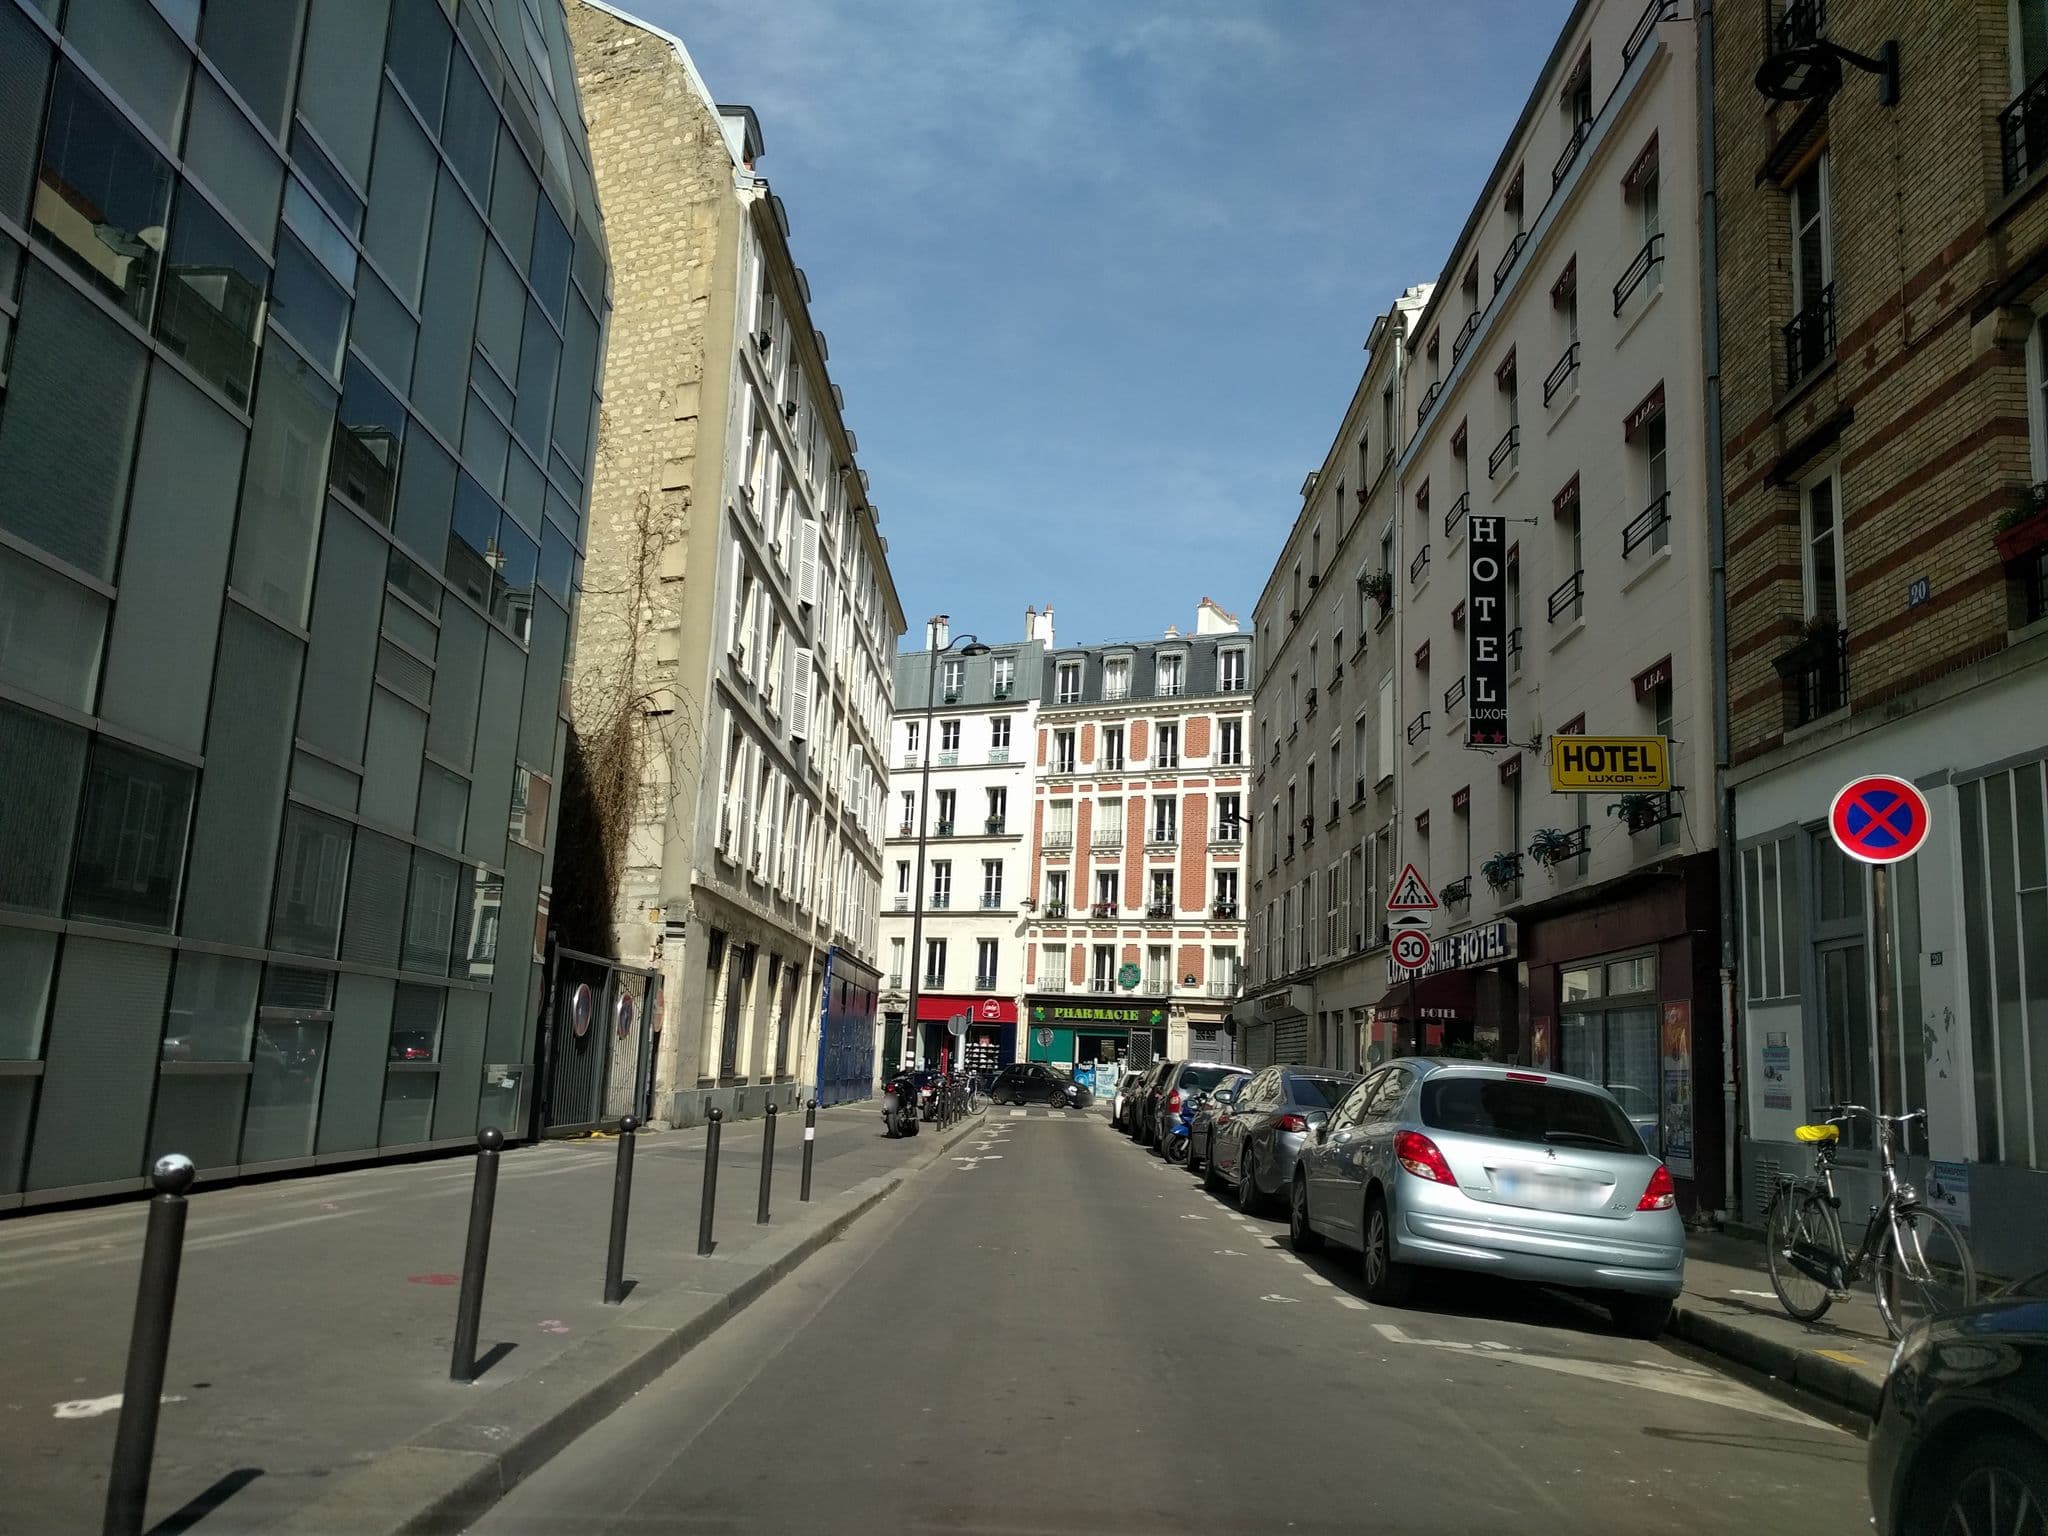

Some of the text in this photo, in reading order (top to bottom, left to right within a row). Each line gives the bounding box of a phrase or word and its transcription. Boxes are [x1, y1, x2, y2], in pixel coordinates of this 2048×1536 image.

[1911, 581, 1926, 605] 20
[1472, 518, 1498, 702] HOTEL
[1469, 708, 1508, 720] LUXOR
[1563, 745, 1657, 773] HOTEL
[1588, 774, 1634, 783] LUXOR
[1399, 941, 1424, 958] 30
[1460, 923, 1504, 965] HOTEL
[1053, 1007, 1139, 1021] PHARMACIE
[1420, 1007, 1458, 1019] HOTEL
